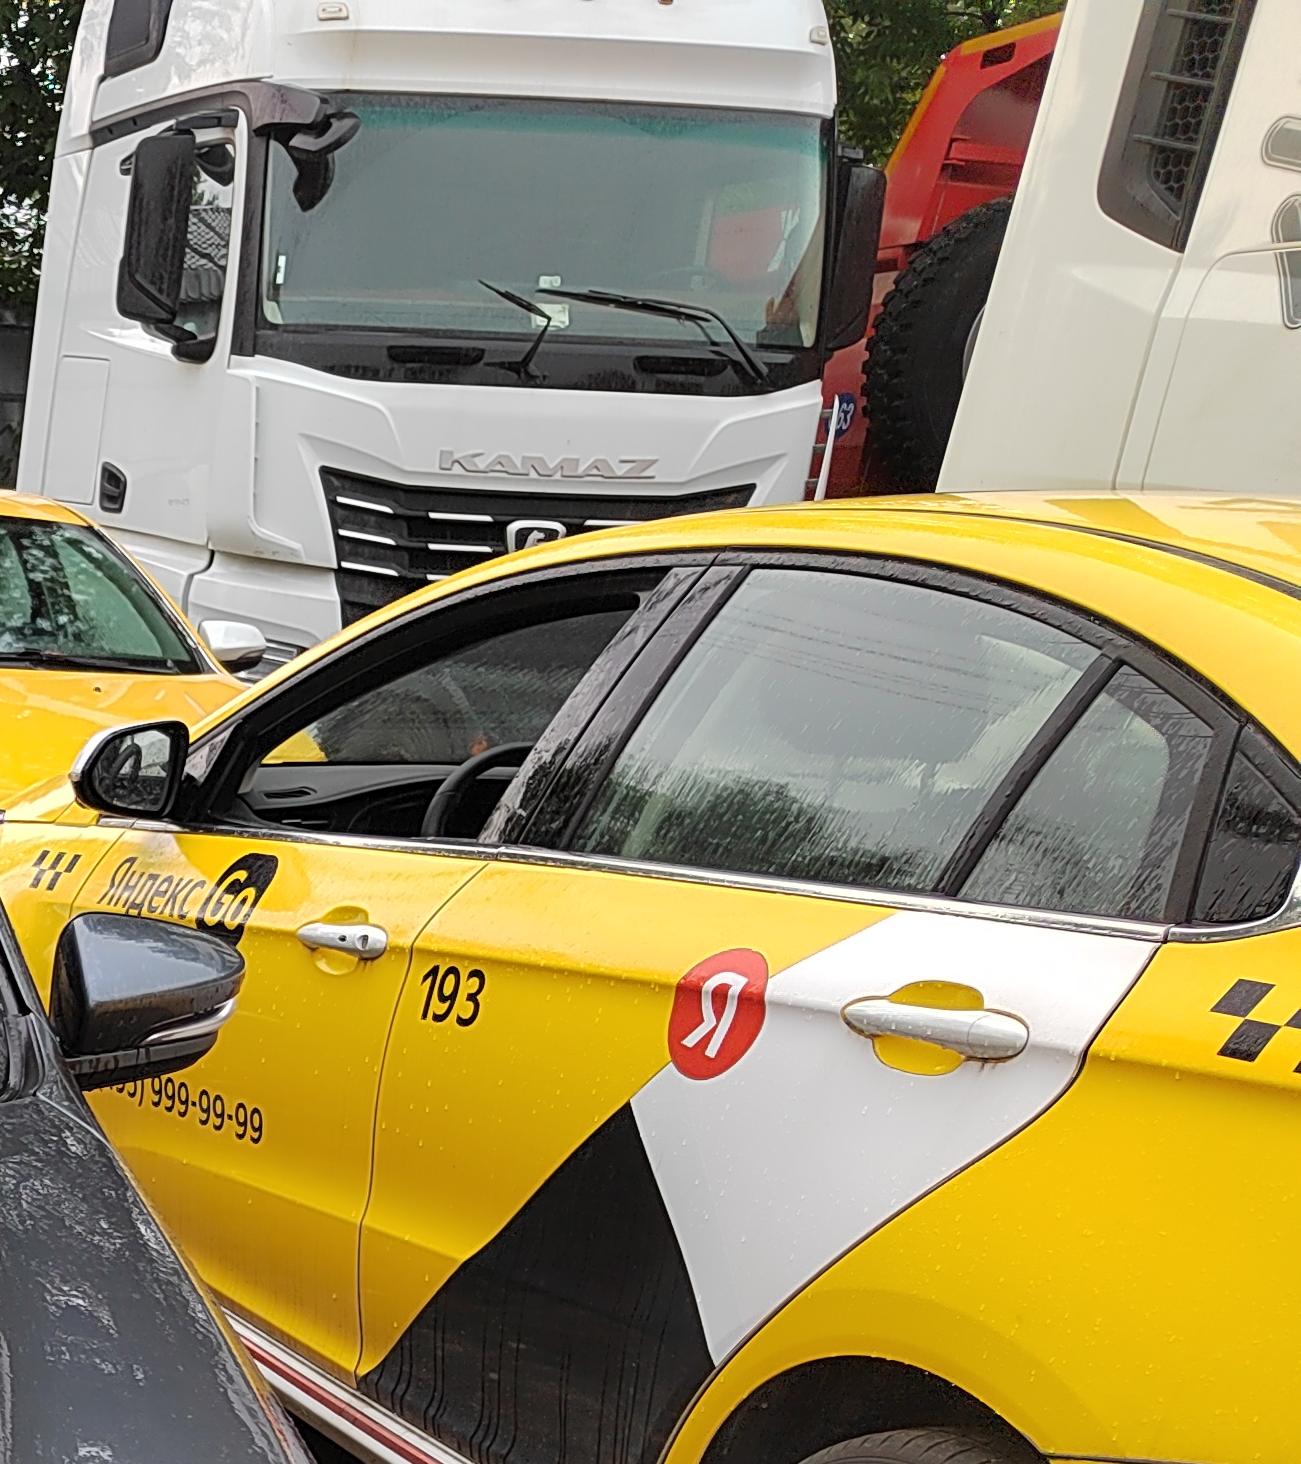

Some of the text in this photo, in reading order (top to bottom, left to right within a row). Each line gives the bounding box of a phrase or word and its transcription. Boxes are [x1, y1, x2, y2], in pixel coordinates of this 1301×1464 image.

[439, 449, 660, 480] KAMAZ
[96, 856, 257, 931] Яндекс Go
[419, 964, 487, 1028] 193
[680, 971, 749, 1059] Я
[150, 1075, 263, 1145] 999-99-99
